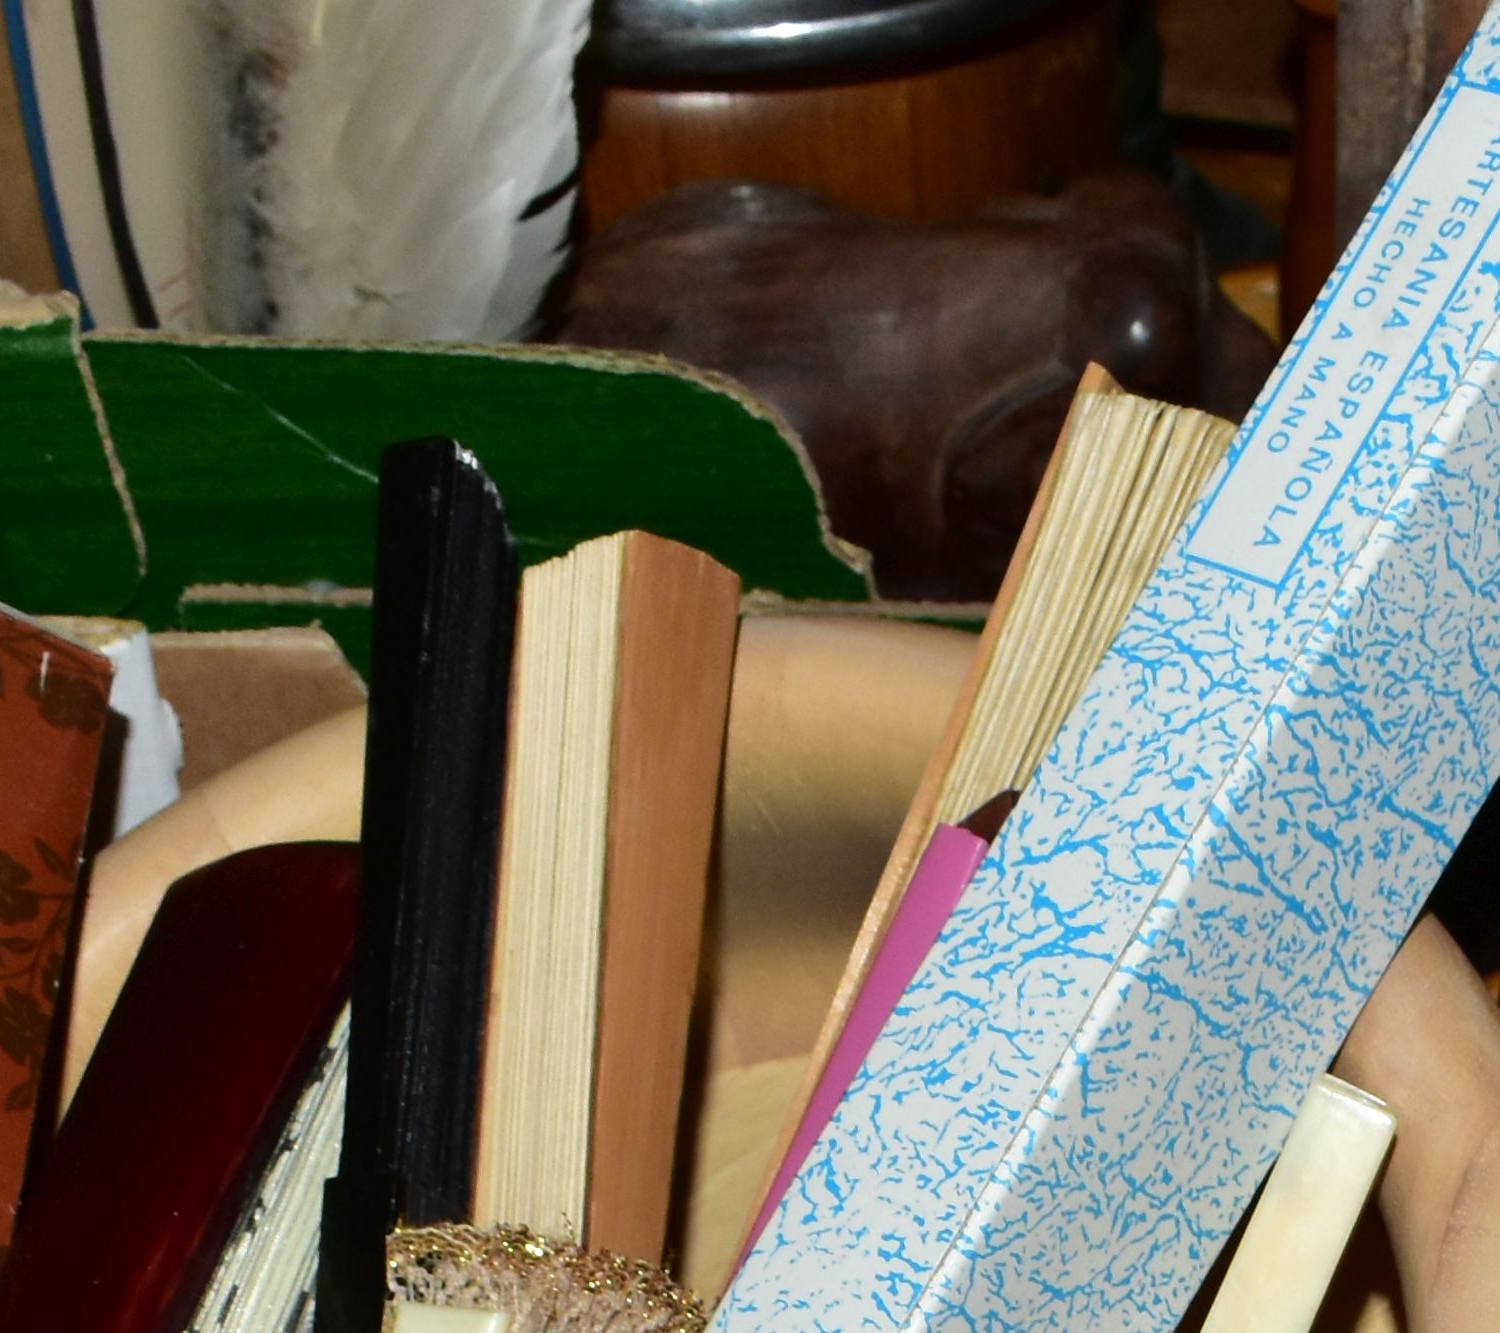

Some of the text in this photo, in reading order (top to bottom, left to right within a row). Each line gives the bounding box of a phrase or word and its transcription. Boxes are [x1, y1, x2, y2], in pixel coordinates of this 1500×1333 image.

[1266, 196, 1431, 454] HECHO A MANO
[1253, 349, 1389, 548] ESPAÑOLA
